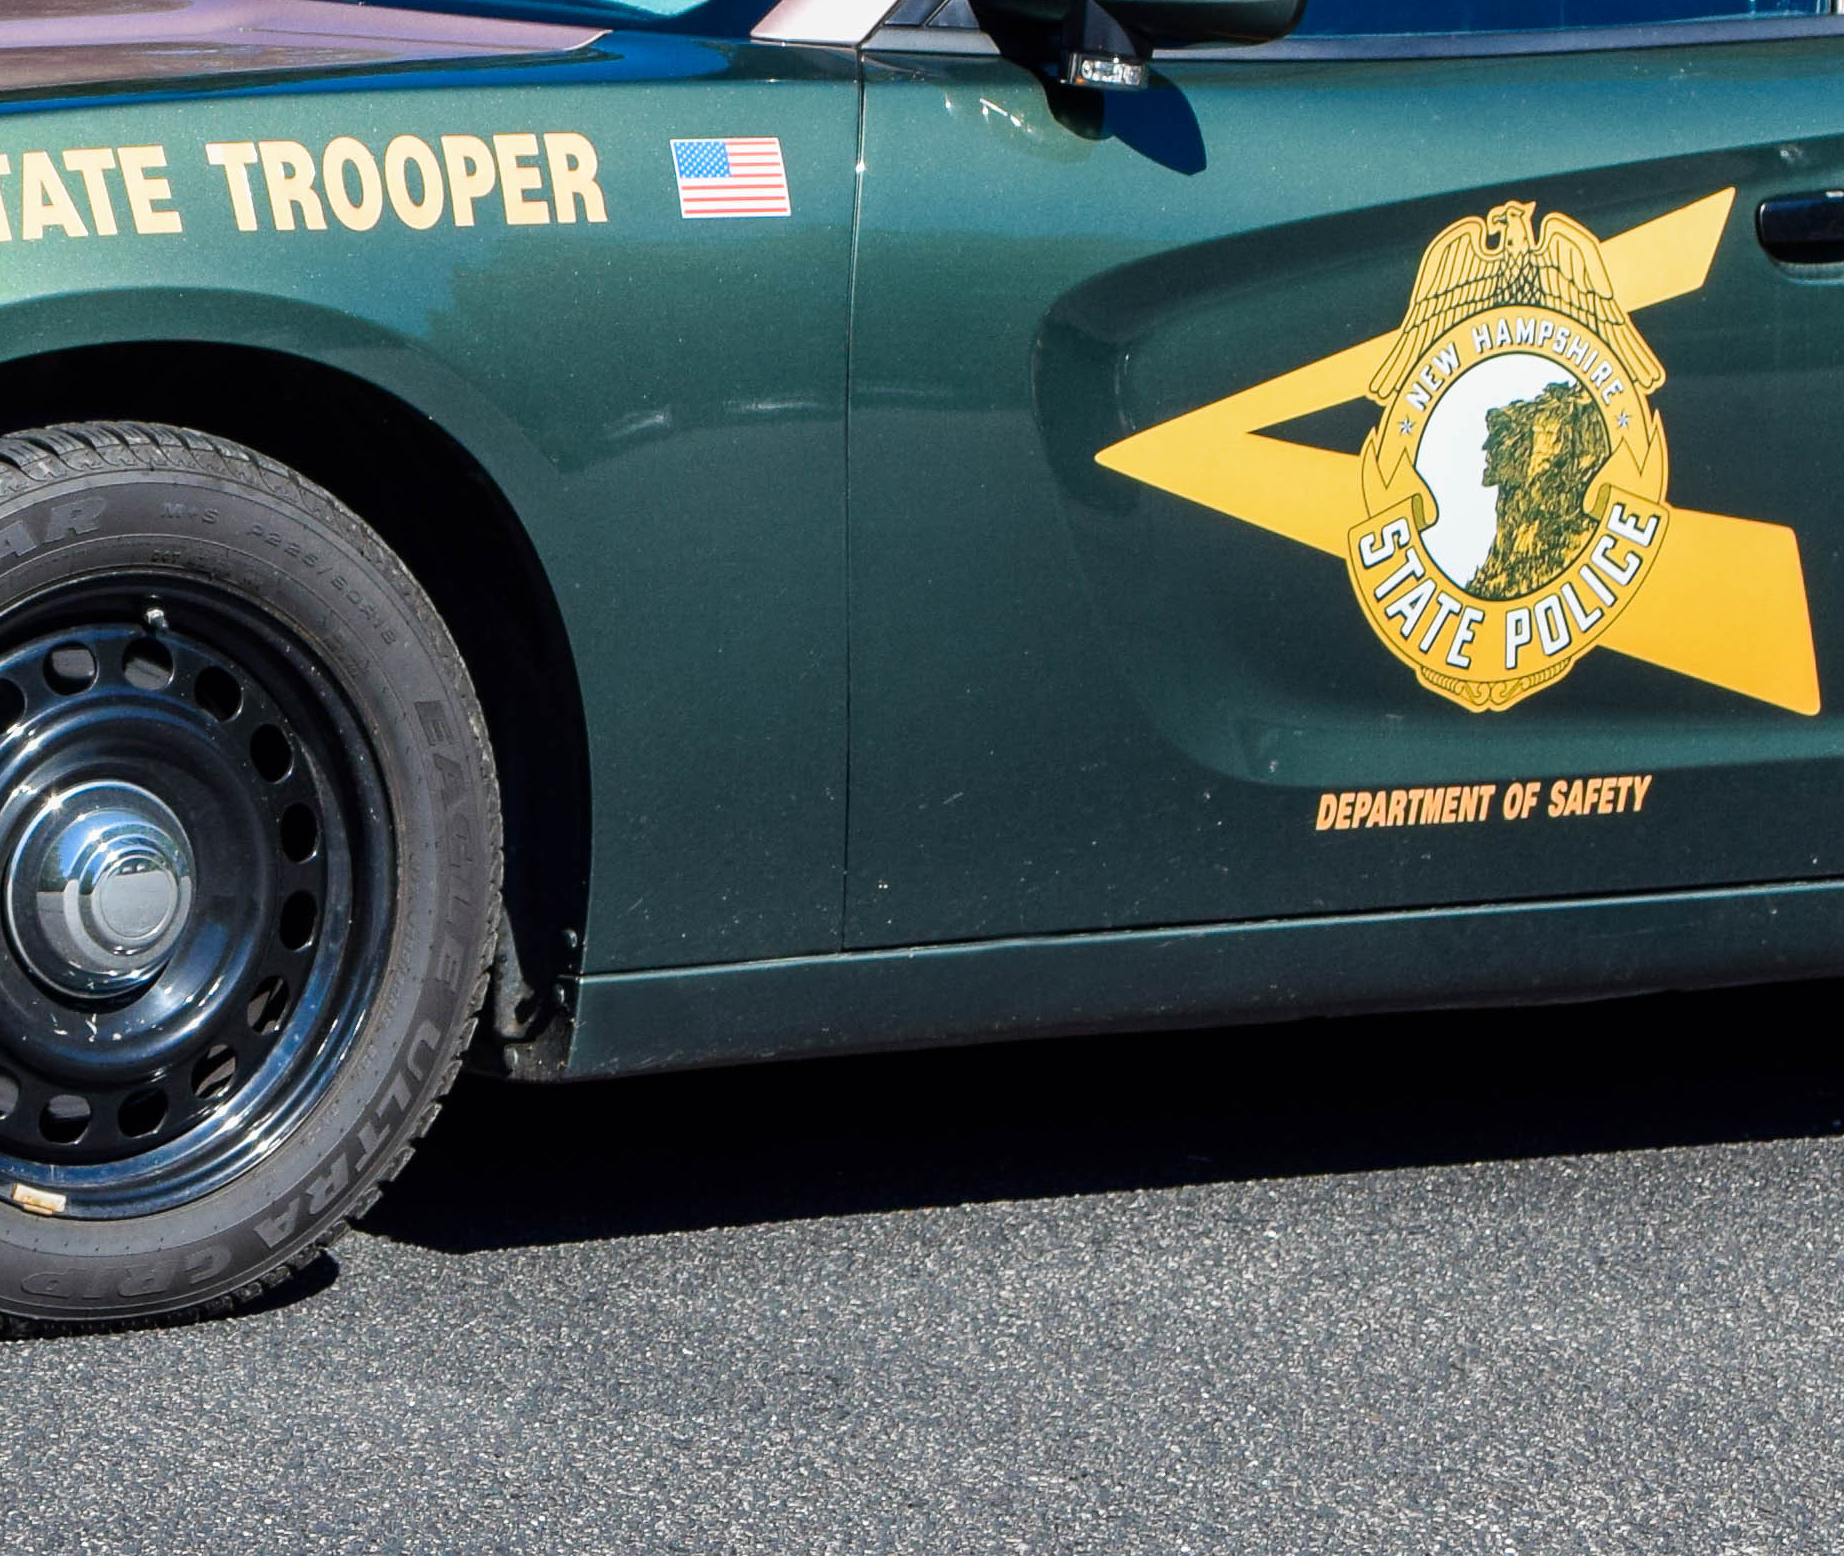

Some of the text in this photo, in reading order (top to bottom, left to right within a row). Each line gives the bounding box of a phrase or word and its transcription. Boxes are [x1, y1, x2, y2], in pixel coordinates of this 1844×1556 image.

[205, 131, 608, 232] TROOPER
[1405, 316, 1626, 412] NEW HAMPSHIRE
[1359, 501, 1659, 669] STATE POLICE
[1315, 774, 1653, 831] DEPARTMENT OF SAFETY
[255, 1019, 441, 1249] ULTRA
[20, 1248, 233, 1301] GRIP
